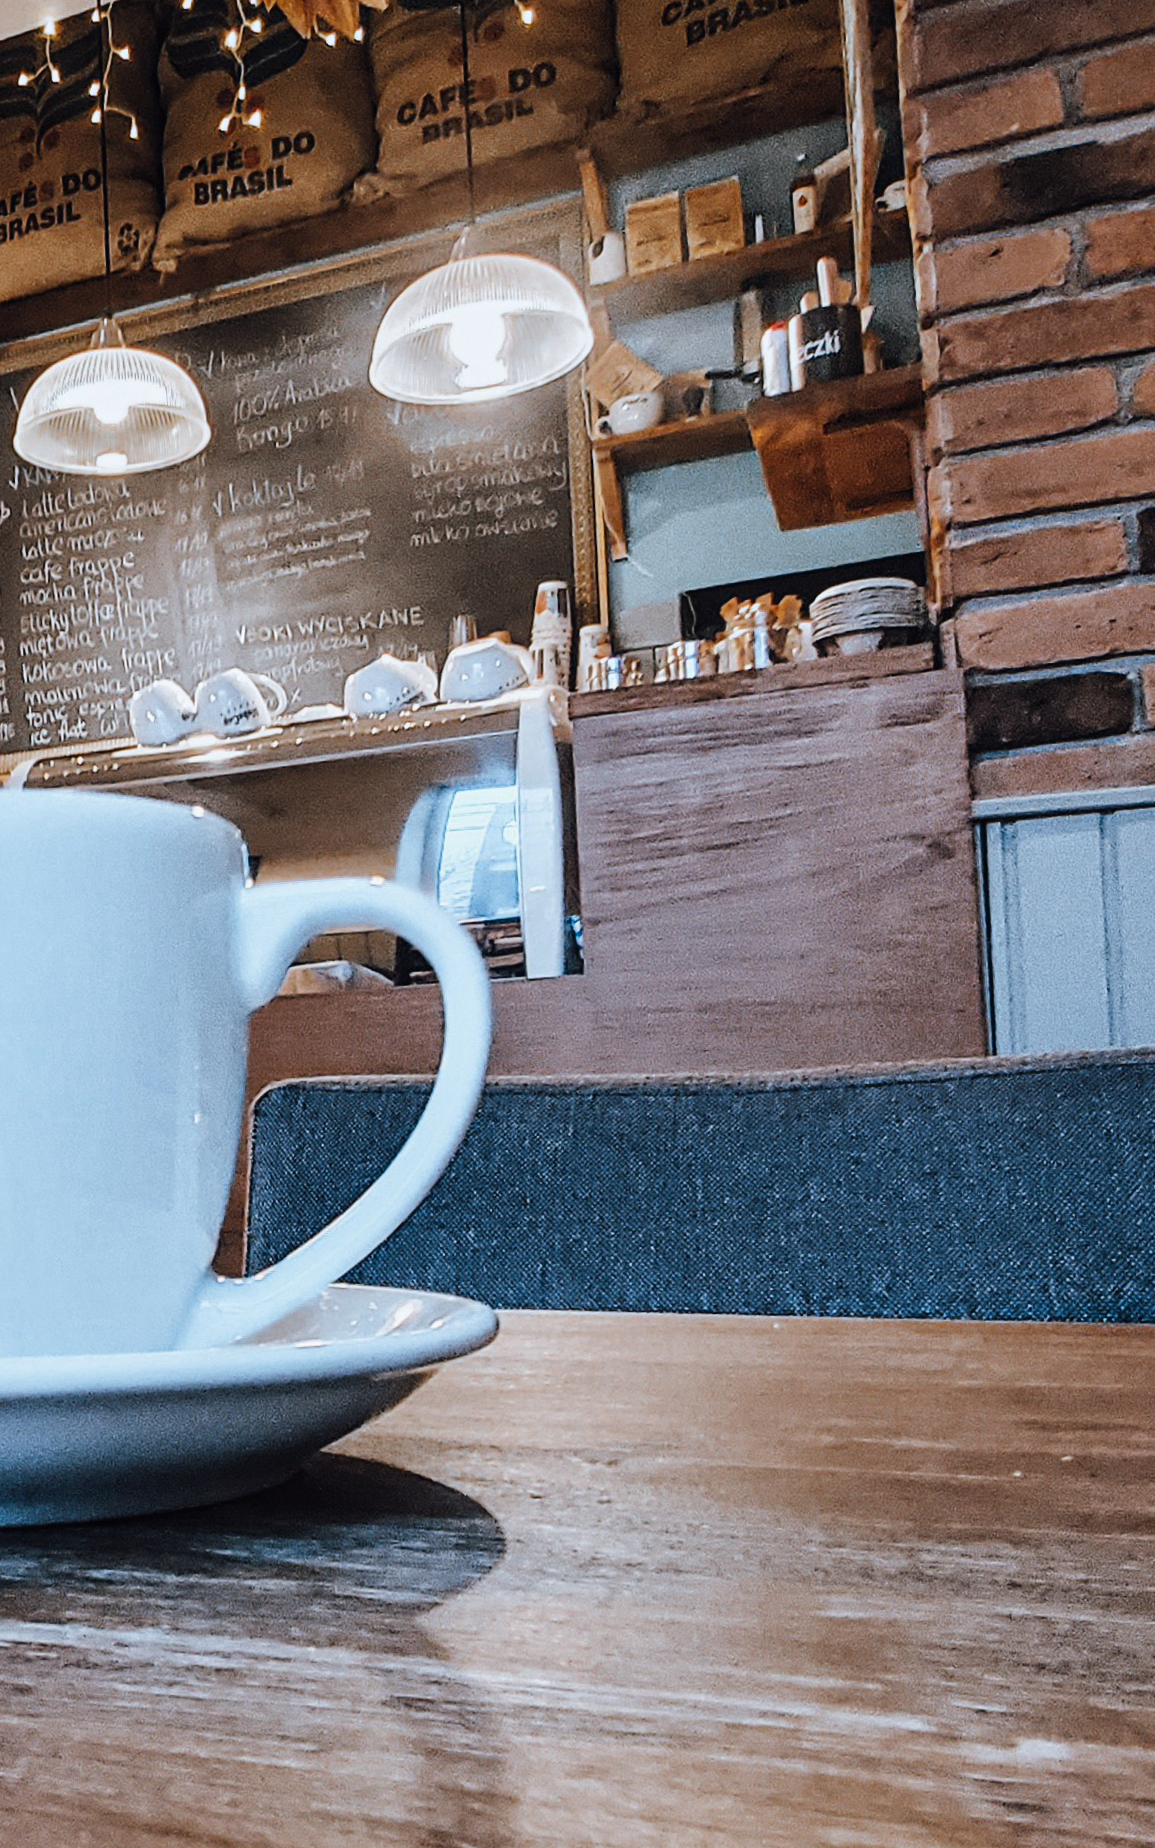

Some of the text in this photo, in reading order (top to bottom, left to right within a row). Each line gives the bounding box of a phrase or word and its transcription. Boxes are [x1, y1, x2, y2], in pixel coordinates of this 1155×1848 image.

[508, 61, 557, 93] DO
[421, 98, 534, 145] BRASIL
[271, 131, 316, 160] DO
[61, 168, 102, 196] DO
[193, 165, 293, 206] BRASIL
[233, 385, 280, 425] 100%
[298, 606, 425, 637] WYCISKANE
